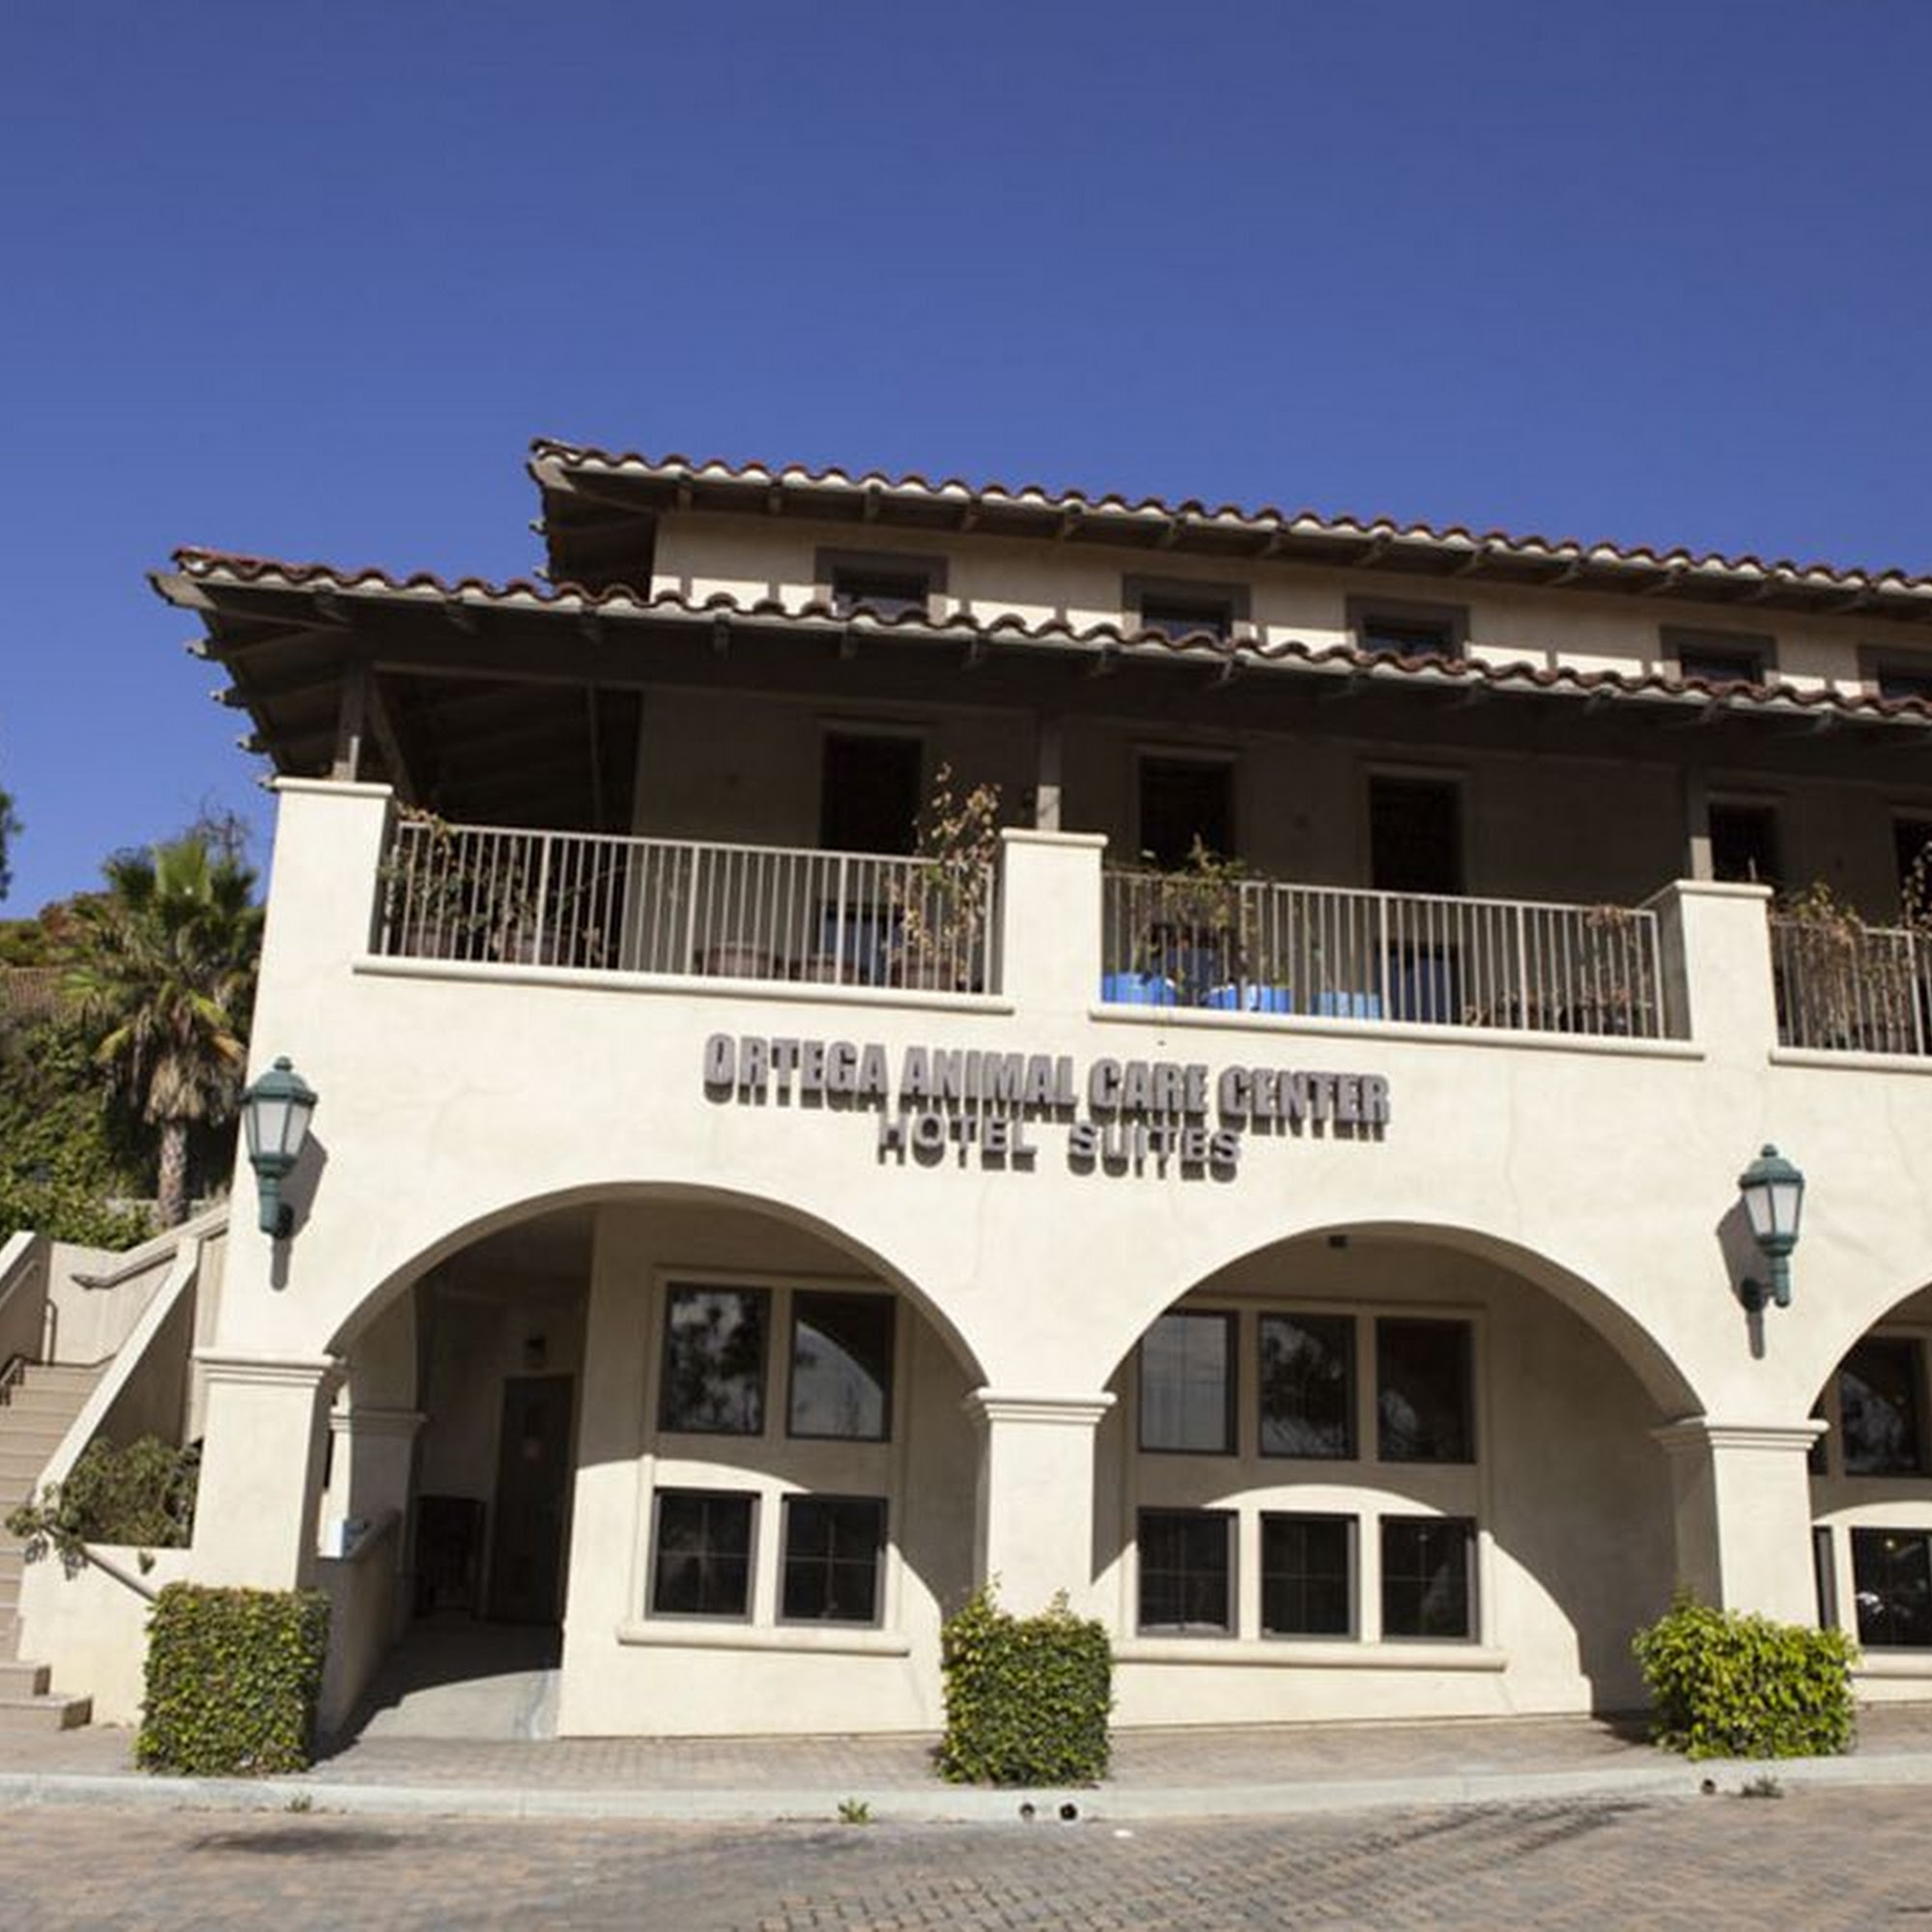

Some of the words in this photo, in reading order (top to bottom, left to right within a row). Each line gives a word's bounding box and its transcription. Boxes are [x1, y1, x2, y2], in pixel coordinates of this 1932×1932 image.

[704, 1034, 888, 1097] ORTEGA
[900, 1046, 1078, 1110] ANIMAL
[1089, 1059, 1209, 1116] CARE
[1218, 1066, 1391, 1126] CENTER
[878, 1113, 1037, 1158] HOTEL
[1069, 1119, 1242, 1166] SUITES
